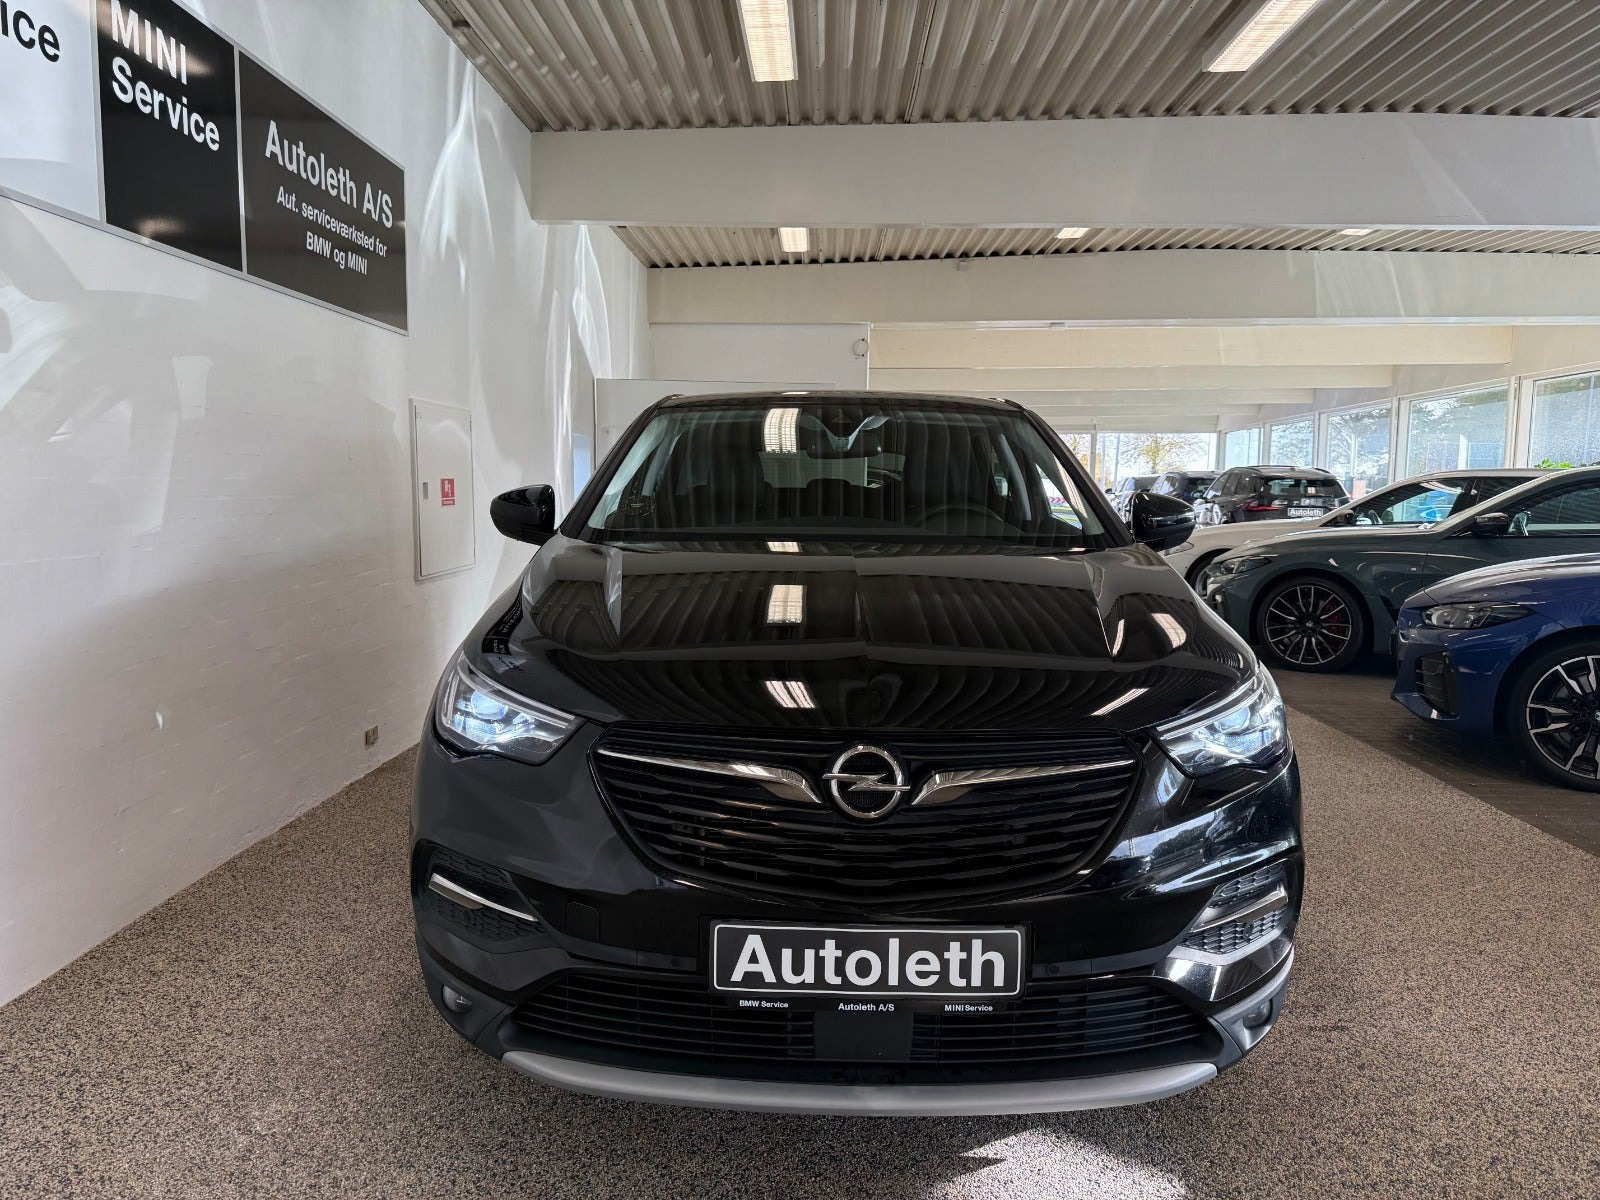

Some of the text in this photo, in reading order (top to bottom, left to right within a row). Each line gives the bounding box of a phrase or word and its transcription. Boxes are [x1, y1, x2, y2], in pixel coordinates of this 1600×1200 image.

[110, 0, 188, 86] MINI
[112, 56, 220, 151] Service
[265, 119, 393, 228] Autoleth A/S
[276, 185, 388, 258] Aut. serviceværksted for
[306, 230, 368, 275] BMW og MINI
[1290, 508, 1321, 516] Autoleth
[730, 934, 1005, 987] Autoleth
[739, 1000, 789, 1009] BMW Service
[838, 1002, 895, 1012] Autoleth A/S
[944, 1004, 994, 1012] MINI Service
